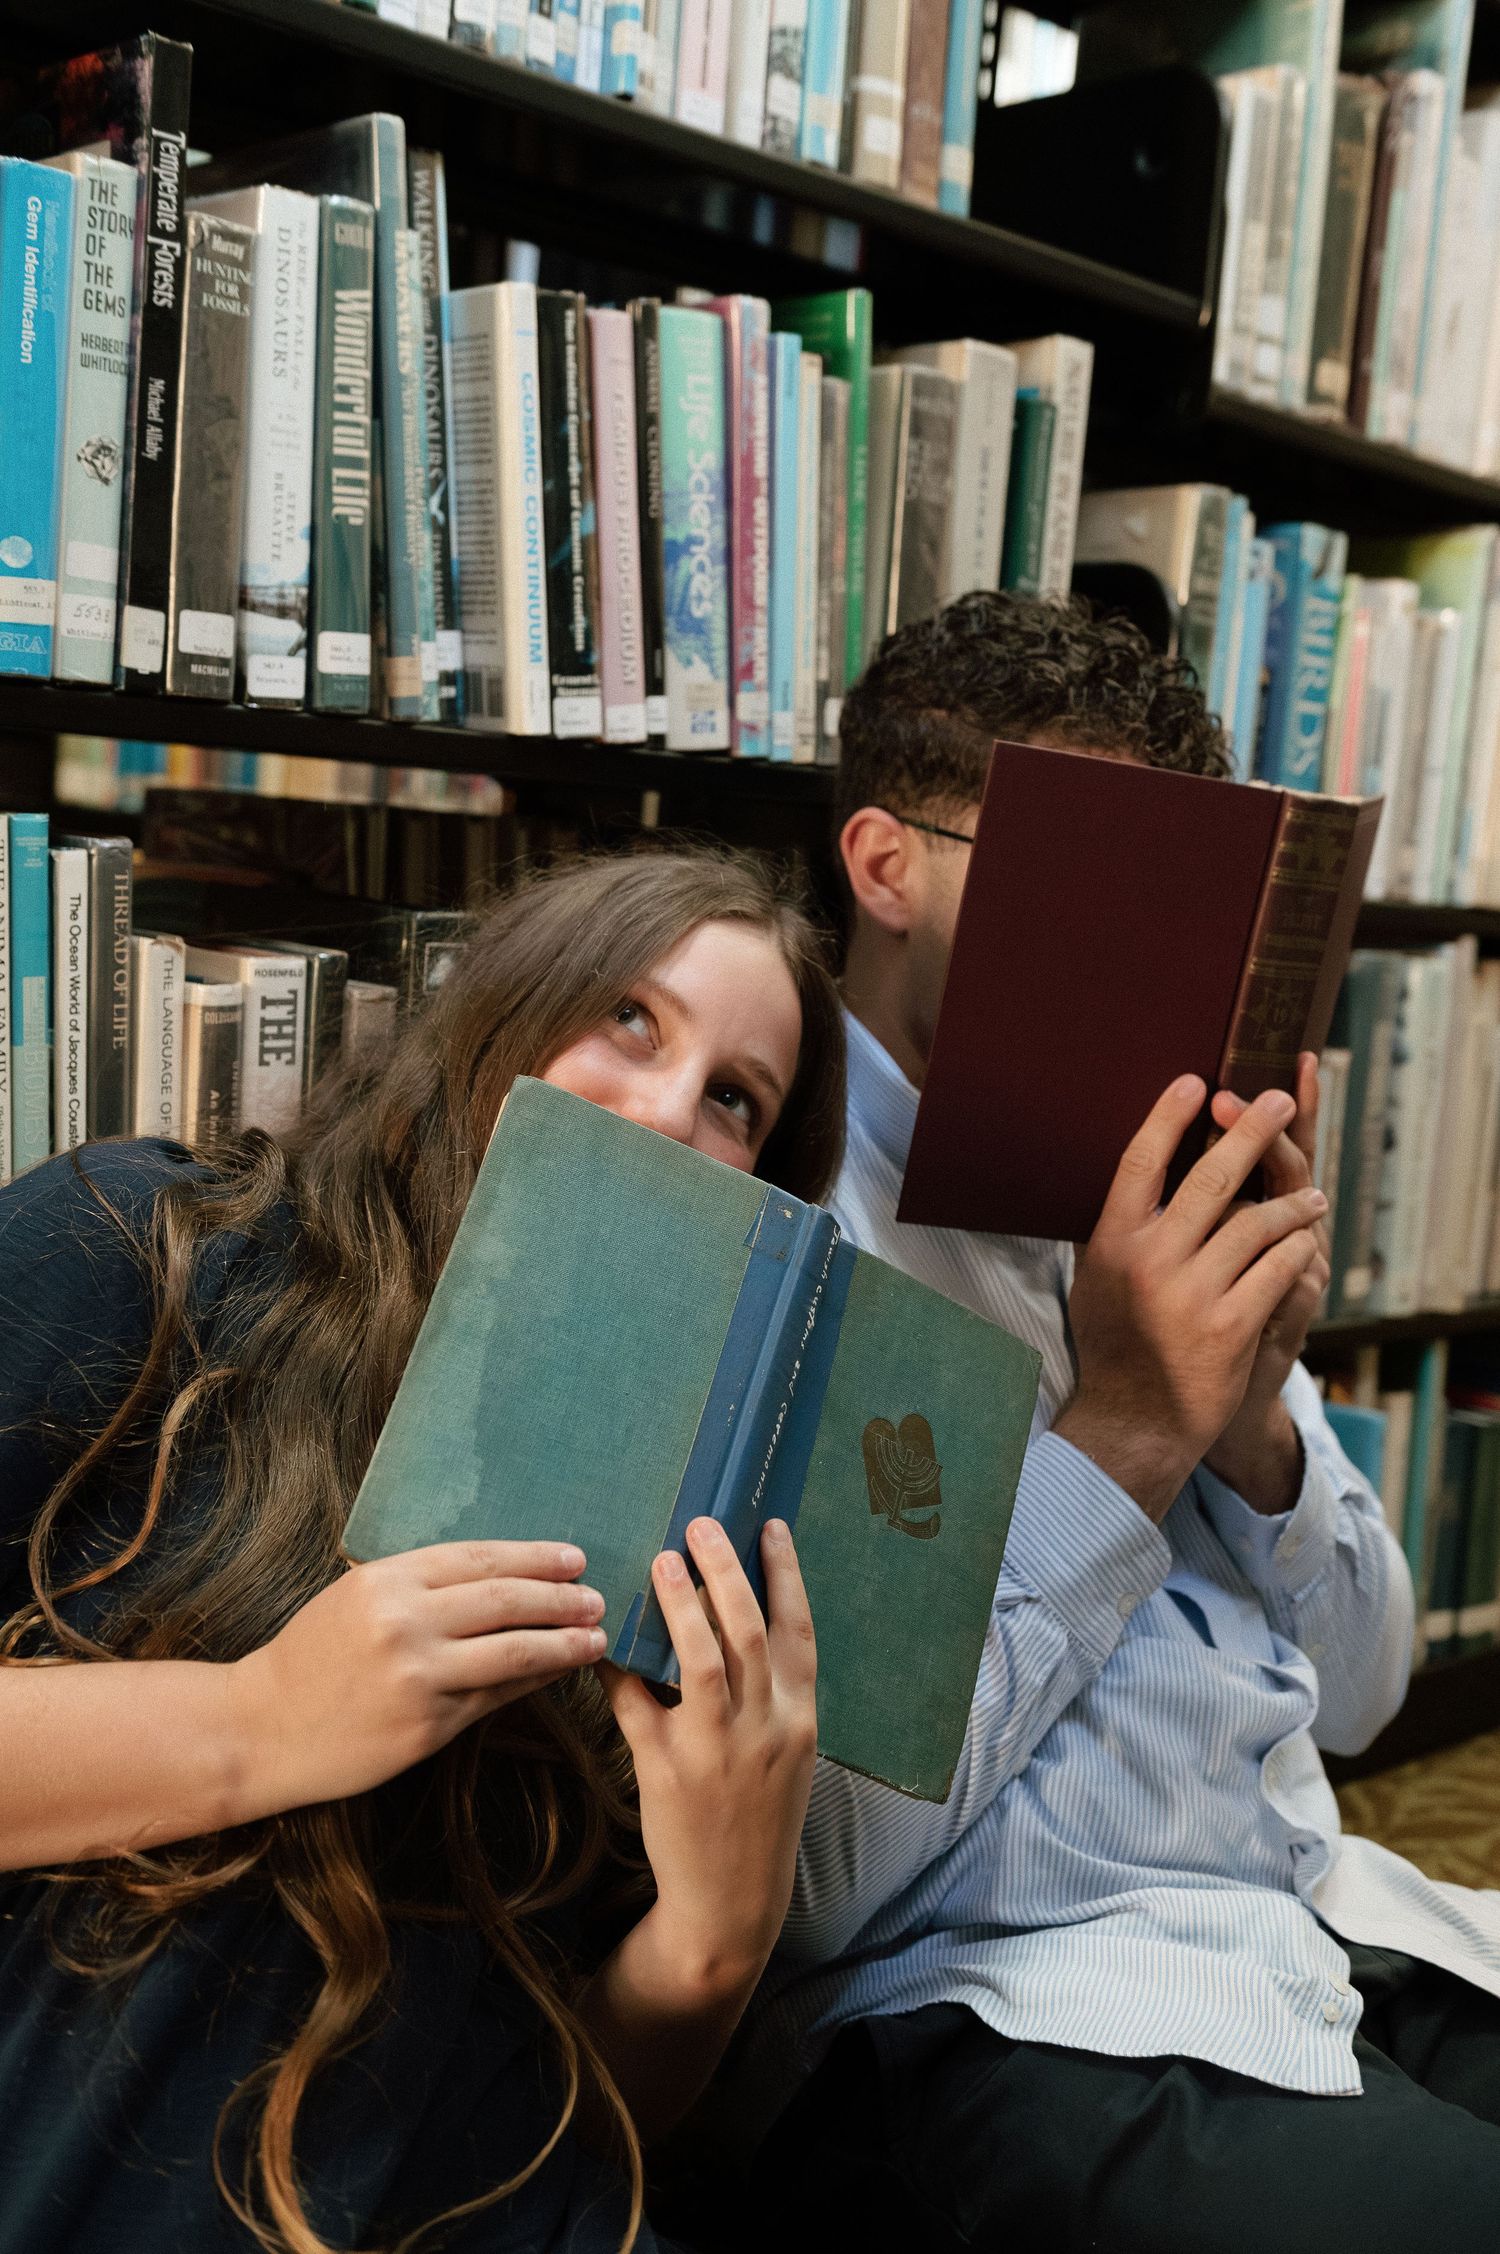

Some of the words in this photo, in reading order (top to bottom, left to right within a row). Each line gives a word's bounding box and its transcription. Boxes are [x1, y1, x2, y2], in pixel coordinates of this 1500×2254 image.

[87, 177, 119, 207] THE
[151, 127, 187, 234] Temperate
[26, 194, 43, 242] Gem
[413, 169, 437, 291] WALKING
[85, 233, 107, 259] OF
[146, 234, 182, 308] Forests
[83, 260, 114, 289] THE
[214, 278, 241, 299] FOR
[20, 244, 40, 365] Identification
[83, 288, 126, 319] GEMS
[202, 291, 251, 317] FOSSILS
[271, 226, 293, 379] DINOSAURS
[147, 376, 167, 424] Michael
[332, 289, 373, 457] Wonderful
[424, 335, 443, 481] DINOSAURS
[522, 372, 539, 484] COSMIC
[679, 374, 716, 439] Life
[141, 423, 165, 462] Allaby
[270, 472, 285, 563] BRUSATTE
[331, 466, 370, 525] Life
[687, 448, 717, 619] Sciences
[525, 494, 544, 664] CONTINUUM
[70, 892, 82, 921] The
[112, 868, 130, 964] THREAD
[69, 925, 82, 973] Ocean
[162, 957, 174, 991] THE
[254, 967, 304, 978] ROSENFELD
[69, 975, 82, 1015] World
[112, 968, 129, 997] OF
[69, 1018, 81, 1031] of
[112, 1001, 128, 1050] LIFE
[161, 996, 174, 1096] LANGUAGE
[258, 989, 298, 1068] THE
[66, 1034, 81, 1095] Jacques
[160, 1101, 172, 1125] OF
[800, 1284, 822, 1350] customs
[788, 1359, 801, 1398] and
[751, 1400, 788, 1509] Ceremonies
